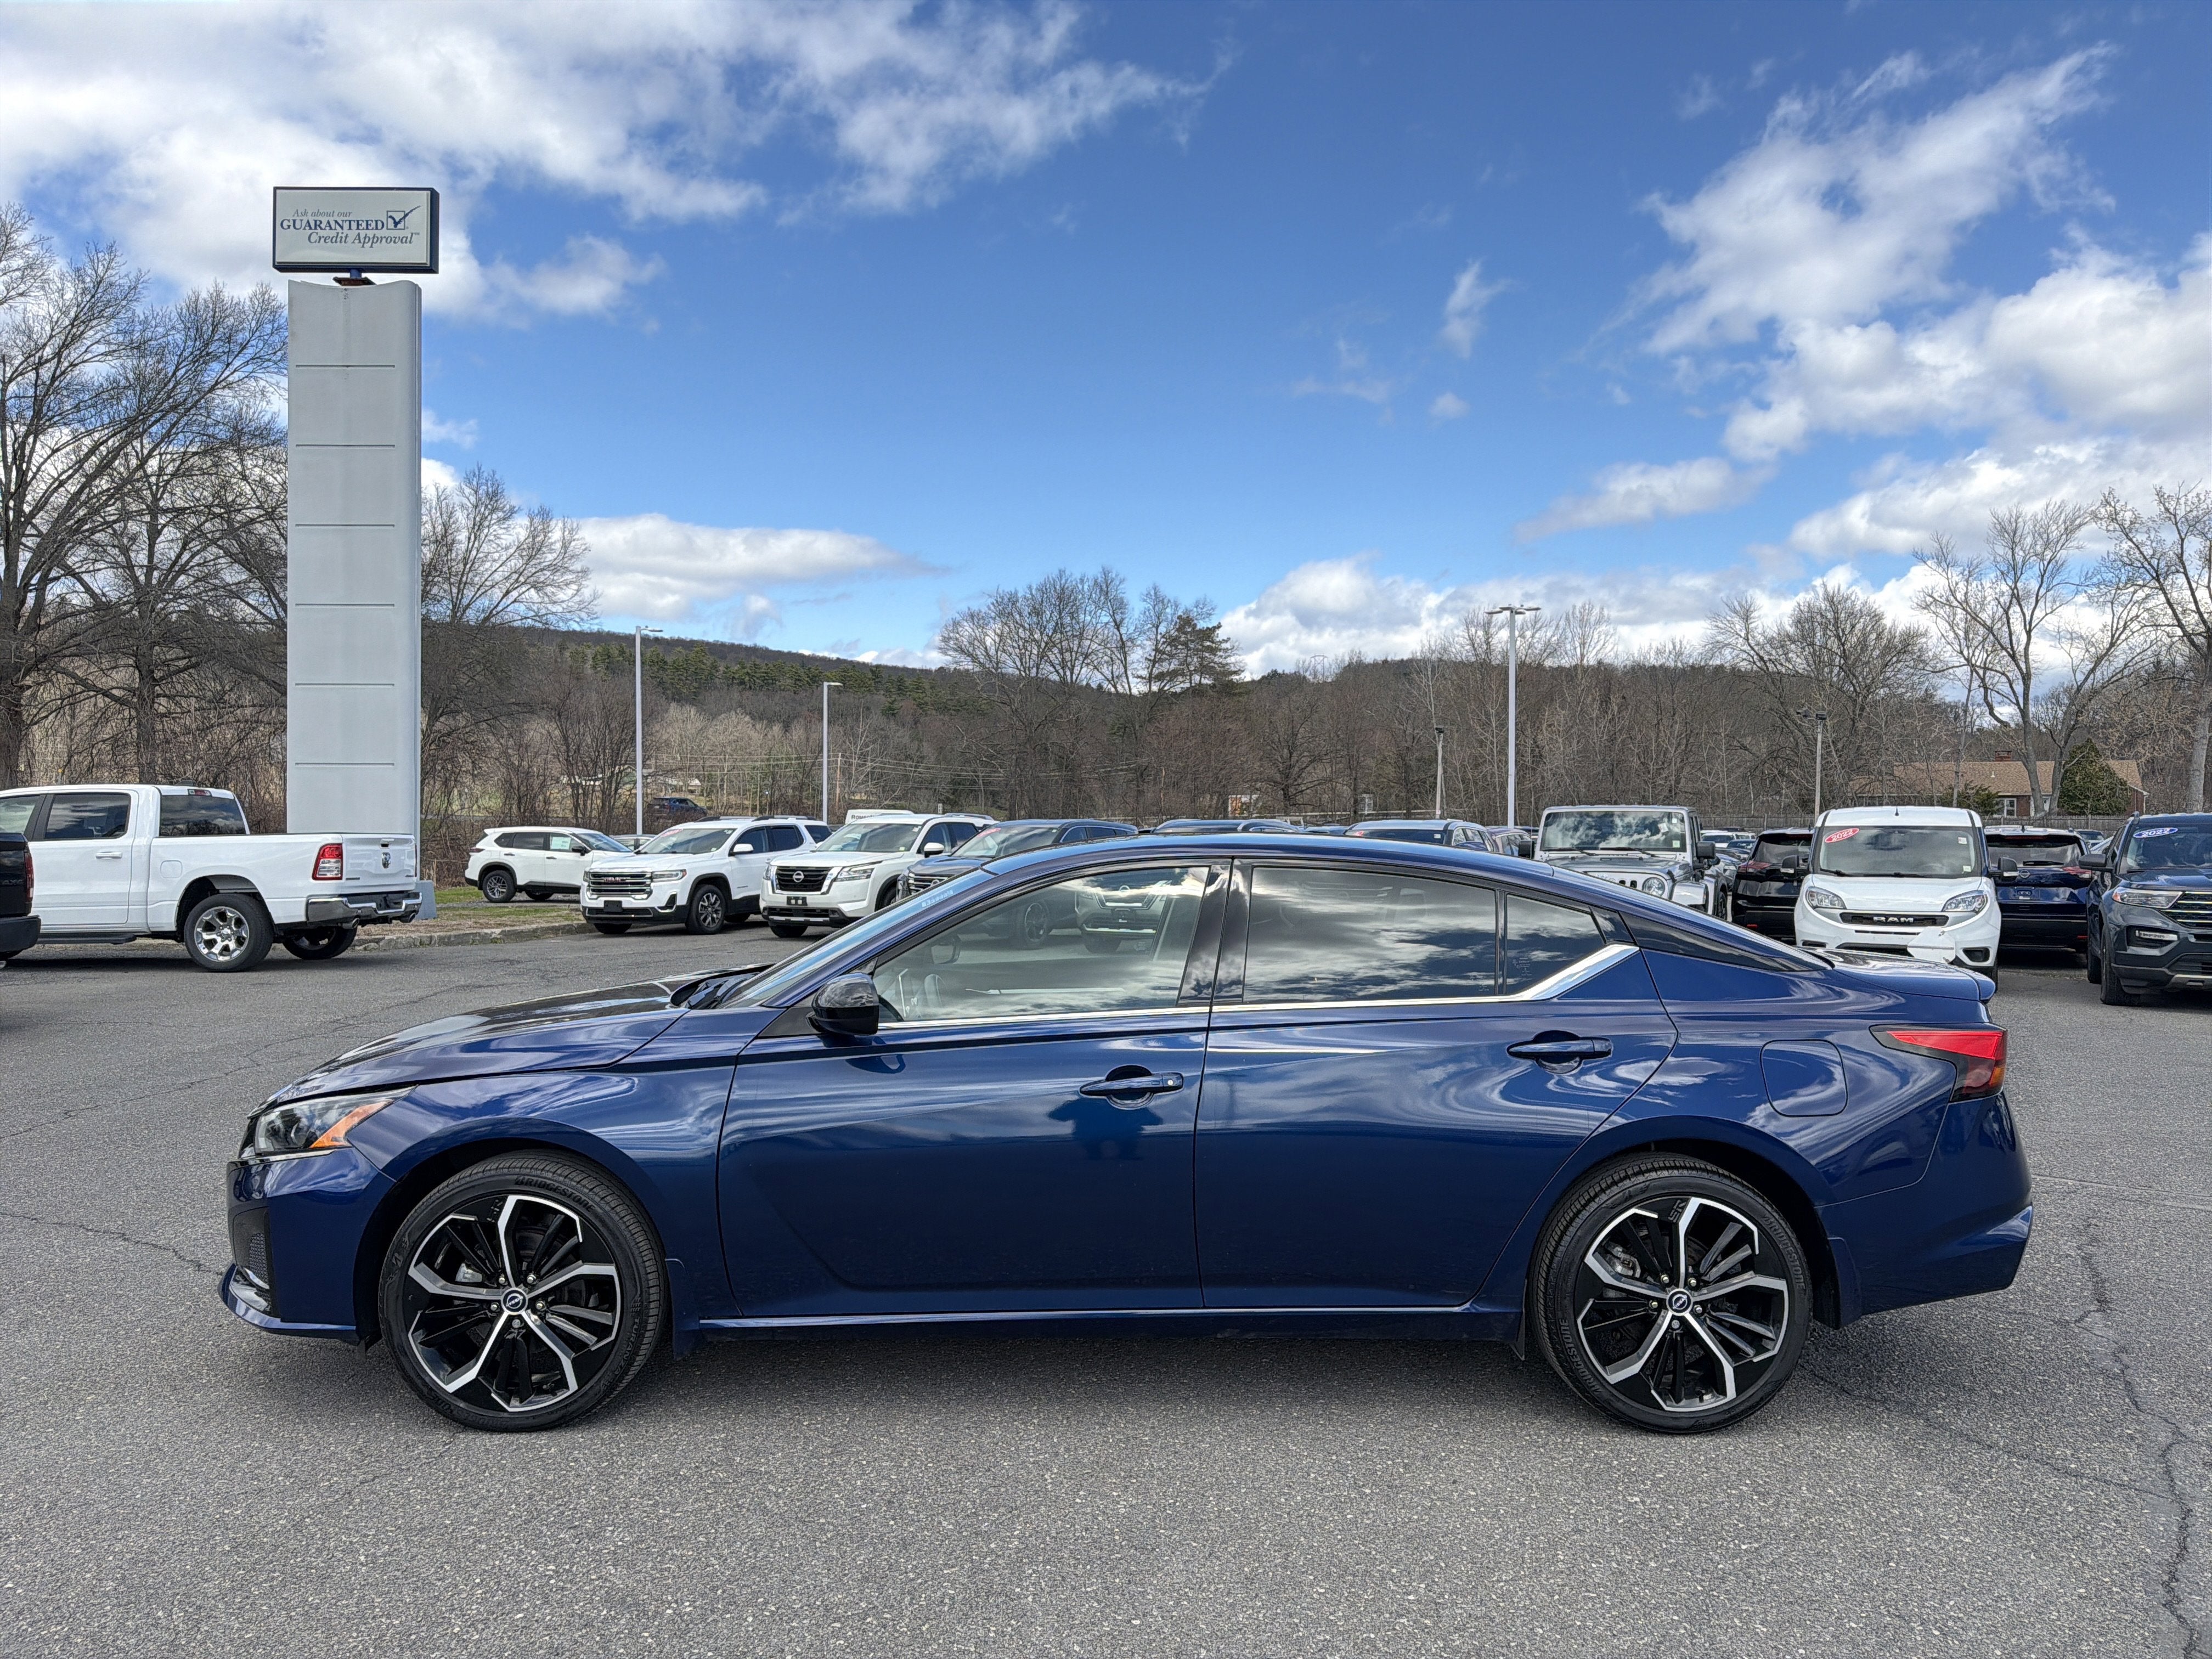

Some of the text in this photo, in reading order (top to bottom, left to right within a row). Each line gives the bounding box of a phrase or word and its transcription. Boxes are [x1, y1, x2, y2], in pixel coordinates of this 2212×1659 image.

[292, 209, 308, 217] Ask
[311, 209, 335, 217] about
[280, 219, 385, 230] GUARANTEED
[308, 232, 414, 248] Credit Approval
[1831, 830, 1853, 841] 2022
[2141, 828, 2171, 837] 2022
[515, 1176, 596, 1212] BRIDGESTONE
[1762, 1214, 1806, 1289] BRIDGESTONE
[614, 1316, 641, 1375] TURANZA
[1559, 1318, 1603, 1396] BRIDGESTONE
